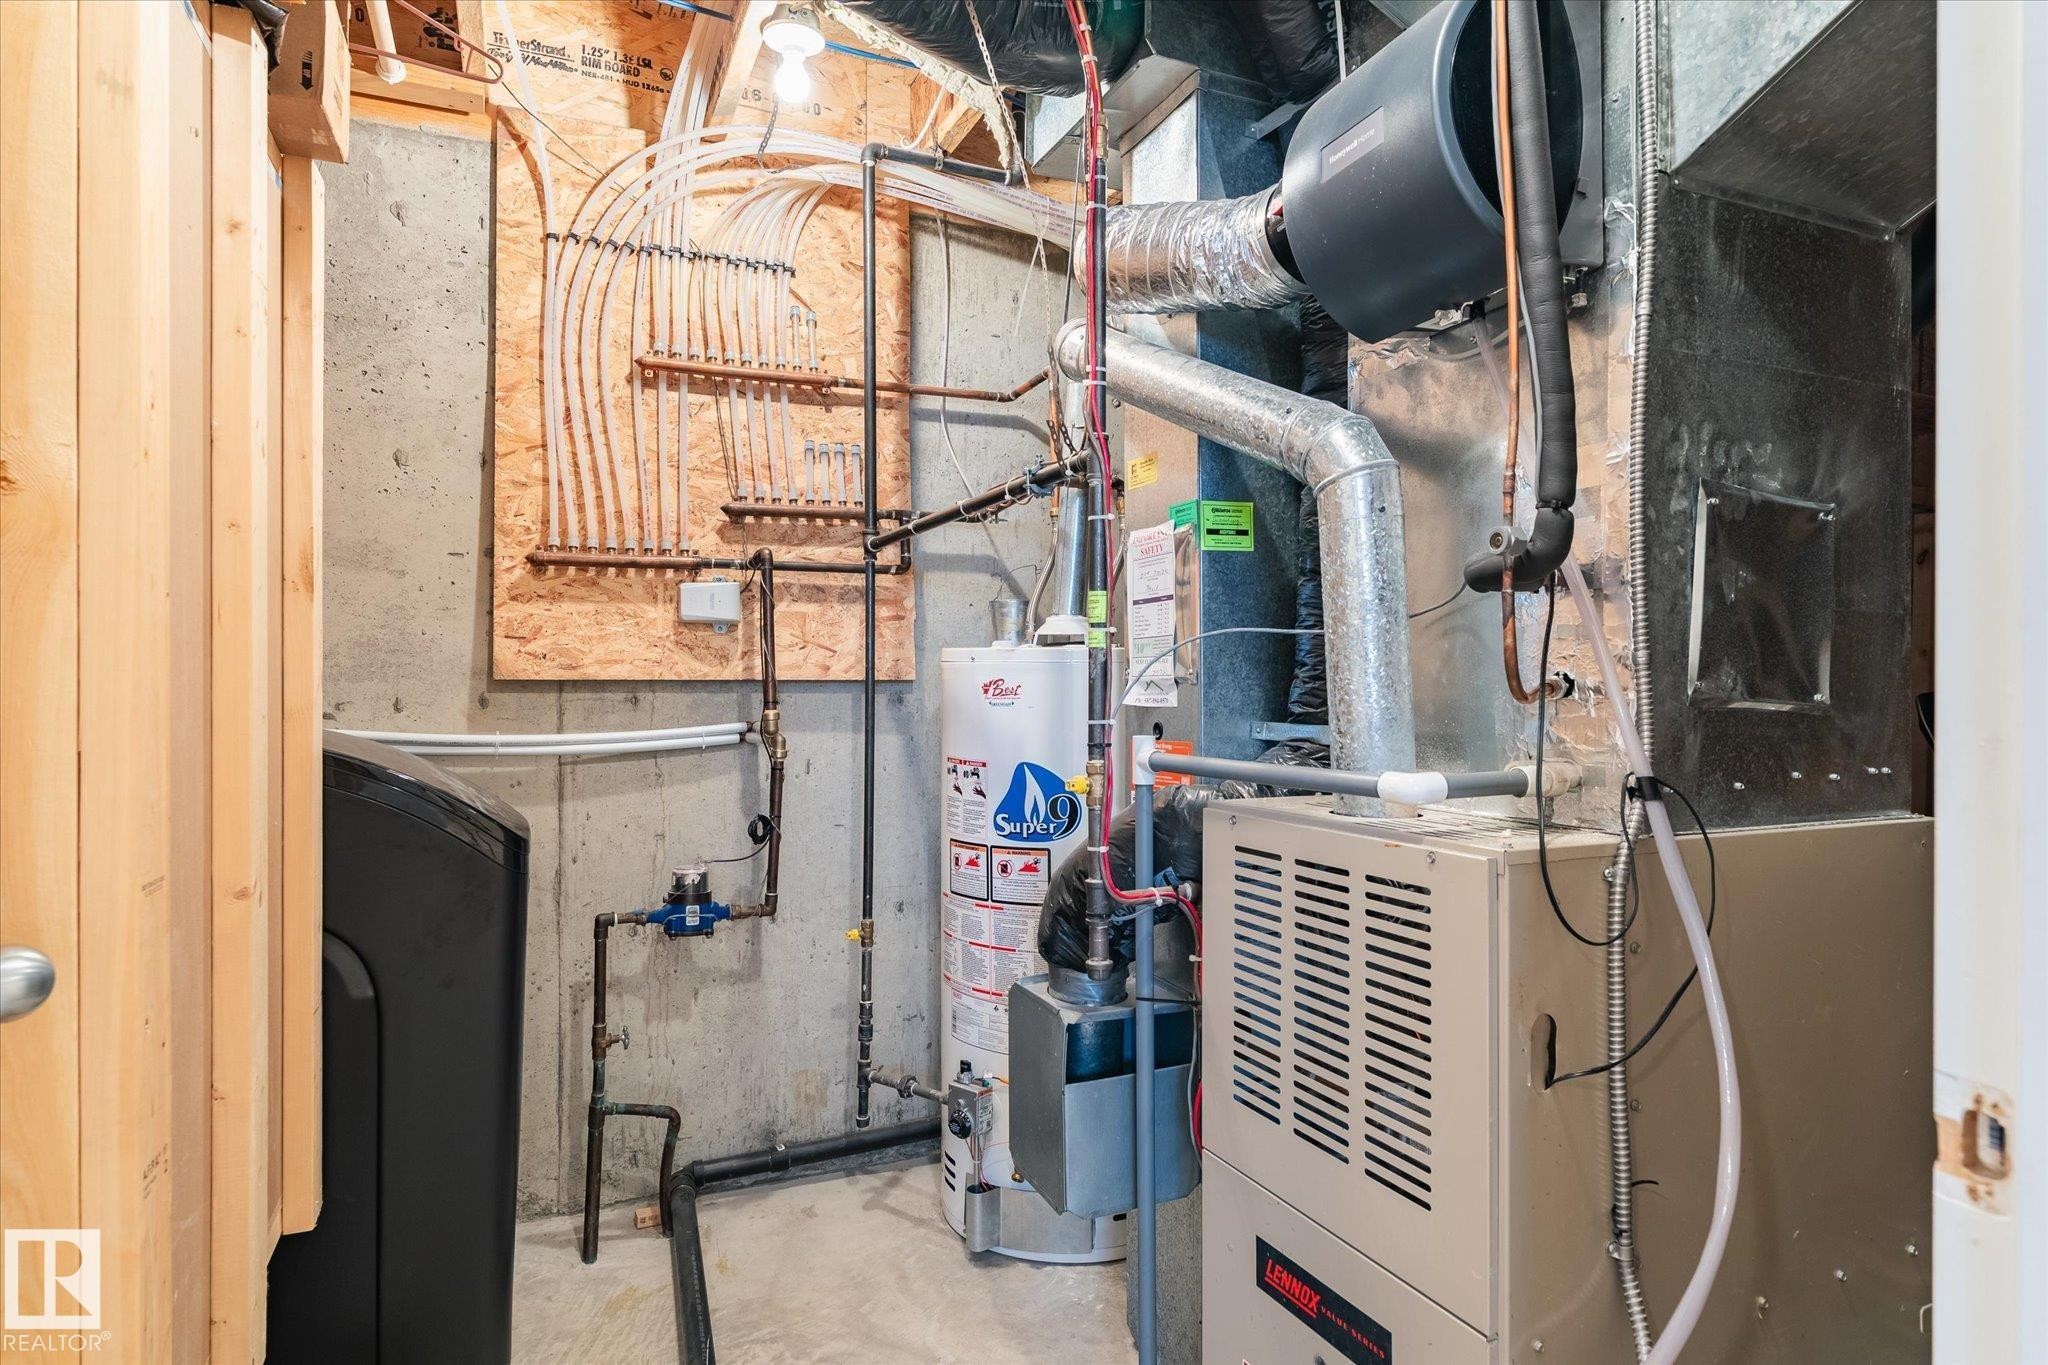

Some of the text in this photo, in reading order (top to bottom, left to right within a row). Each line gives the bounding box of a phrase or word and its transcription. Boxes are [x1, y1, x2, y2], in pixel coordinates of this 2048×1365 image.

[580, 55, 641, 78] RIM BOARD
[1329, 127, 1376, 165] Honeywell Home
[992, 678, 1022, 697] Best
[995, 813, 1058, 838] Super
[1047, 793, 1081, 840] 9
[1264, 1258, 1386, 1360] LENNOX VALUE SERIES
